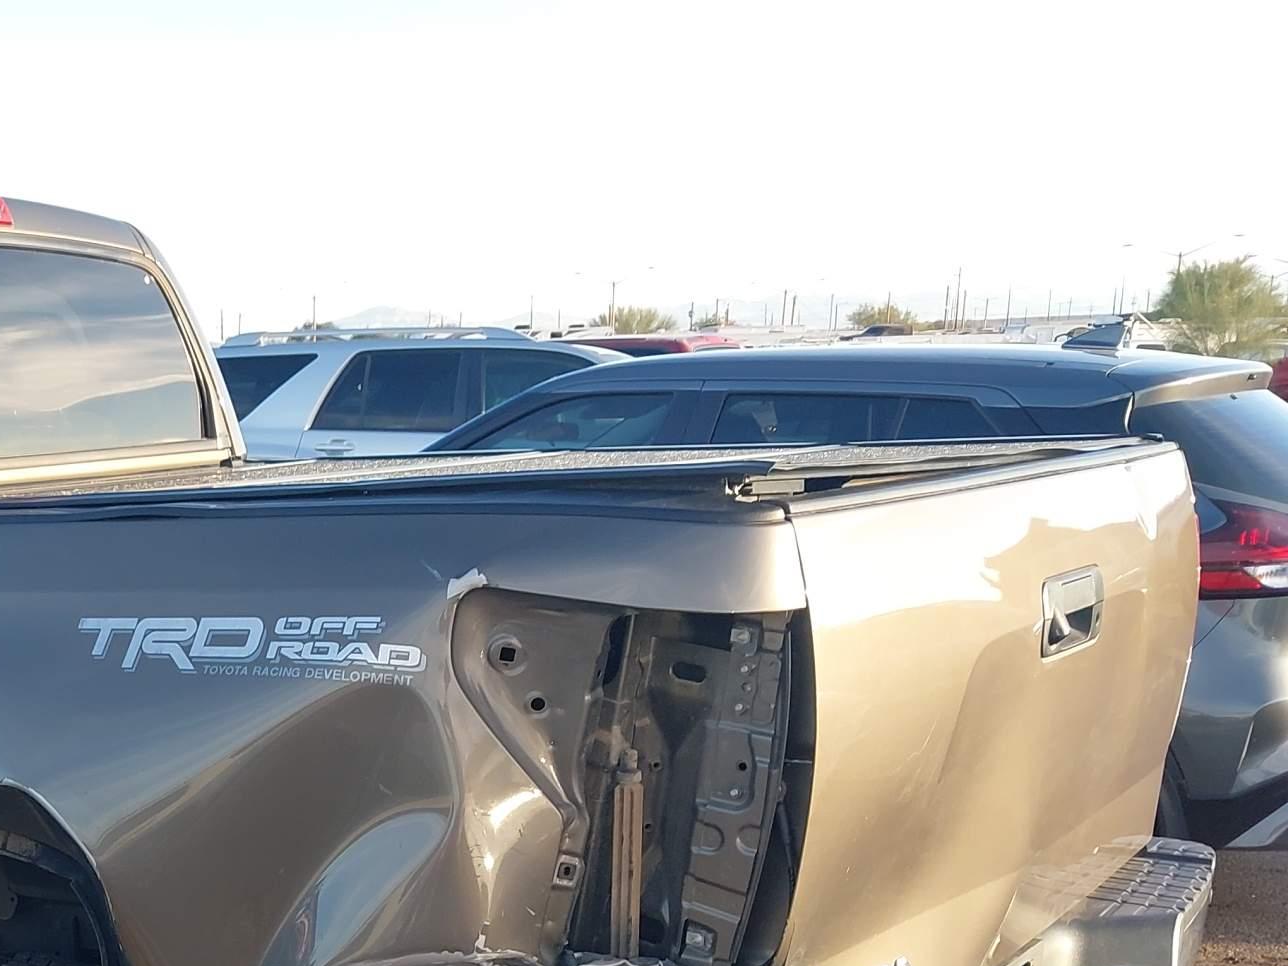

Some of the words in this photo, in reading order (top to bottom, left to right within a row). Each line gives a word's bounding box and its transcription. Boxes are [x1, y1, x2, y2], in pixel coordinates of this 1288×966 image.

[274, 616, 386, 636] OFF
[78, 617, 269, 674] TRD
[266, 641, 427, 673] ROAD
[203, 663, 250, 677] TOYOTA
[252, 666, 301, 679] RACING
[304, 669, 415, 687] DEVELOPMENT
